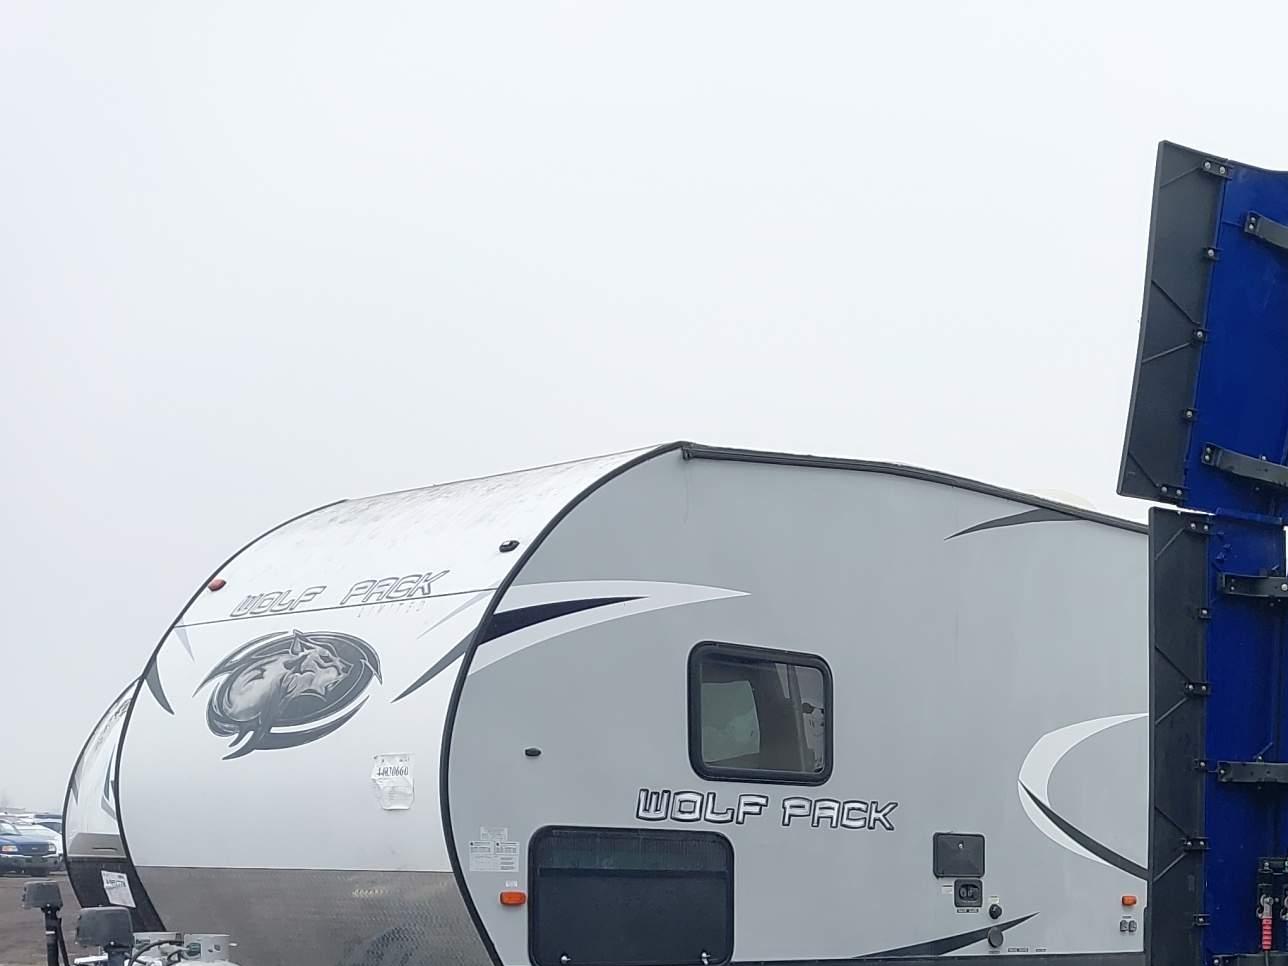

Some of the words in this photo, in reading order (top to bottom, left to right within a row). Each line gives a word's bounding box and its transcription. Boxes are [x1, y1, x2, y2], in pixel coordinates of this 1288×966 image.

[229, 585, 327, 618] WOLF
[340, 569, 451, 606] PACK
[636, 788, 769, 824] WOLF
[781, 796, 899, 831] PACK
